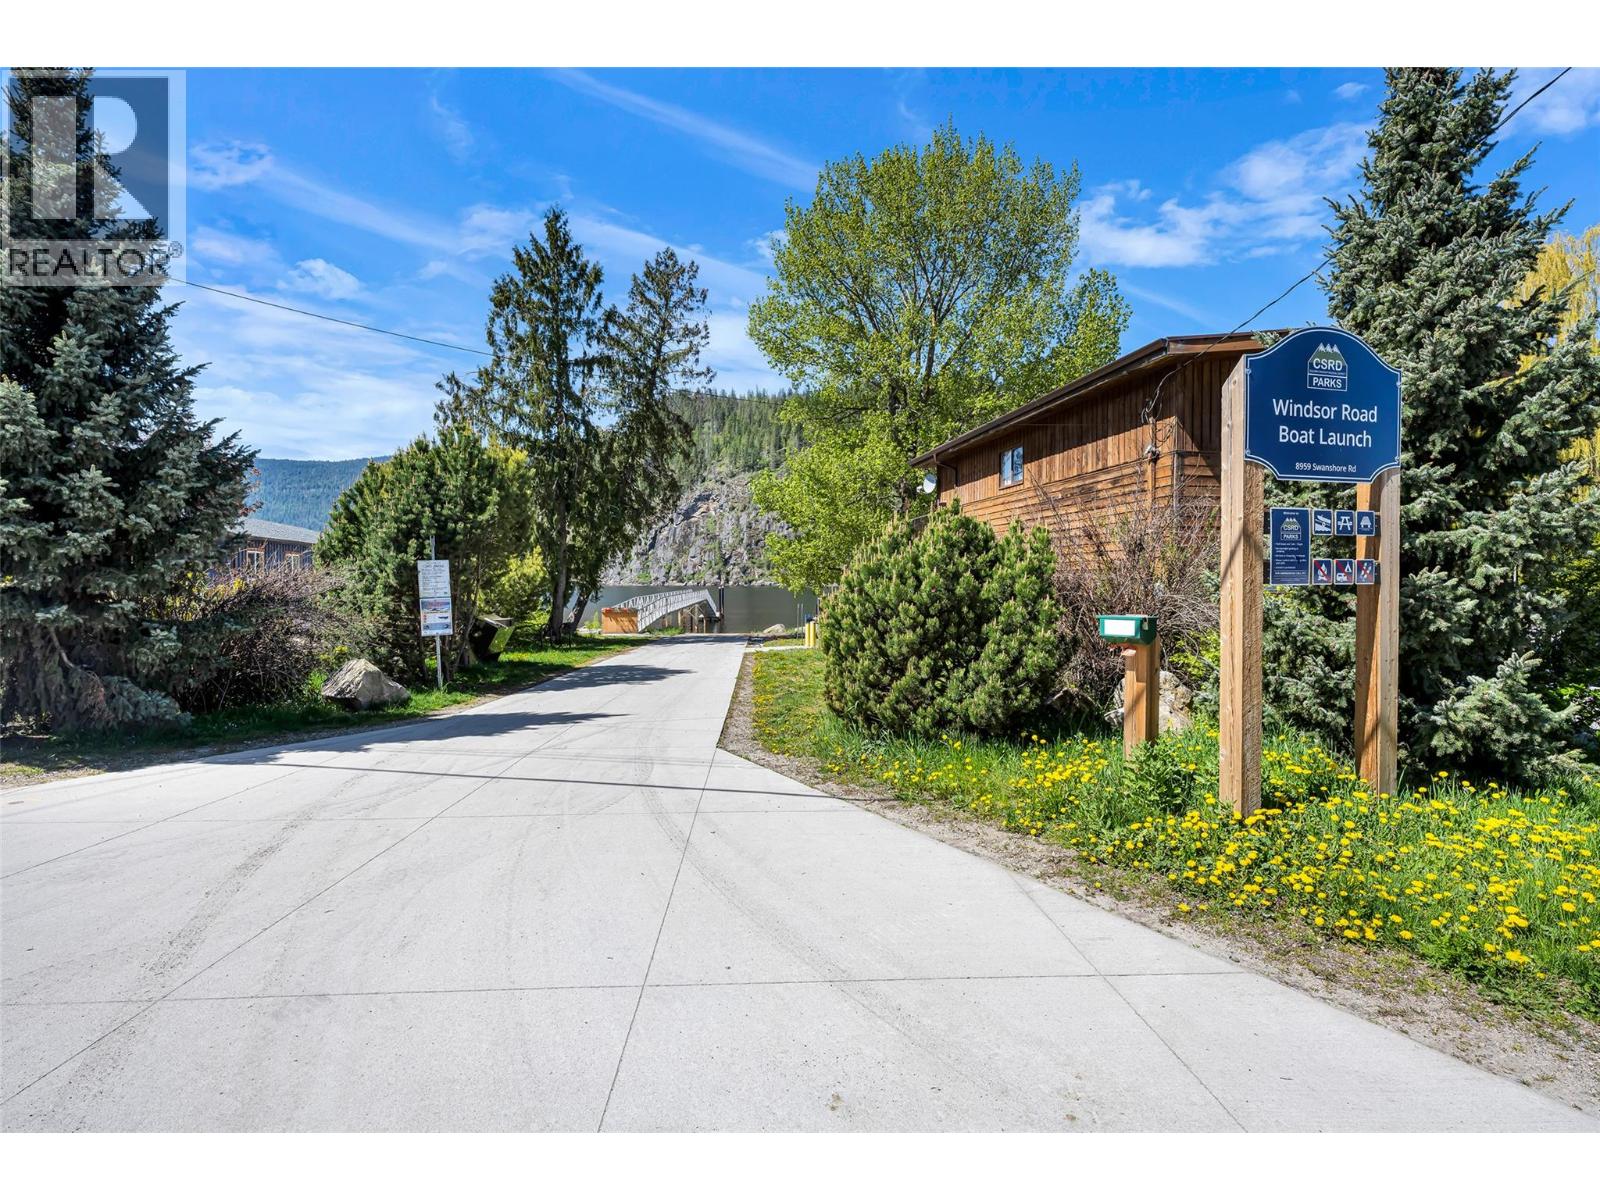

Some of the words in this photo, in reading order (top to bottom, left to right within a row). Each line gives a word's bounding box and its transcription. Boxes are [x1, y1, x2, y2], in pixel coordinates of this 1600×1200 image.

[1312, 358, 1343, 371] CSRD
[1312, 377, 1342, 389] PARKS
[1272, 398, 1337, 420] Windsor
[1341, 404, 1378, 423] Road
[1279, 425, 1315, 444] Boat
[1319, 428, 1372, 447] Launch
[1295, 462, 1311, 471] 8959
[1312, 463, 1347, 472] Swanshore
[1348, 464, 1357, 473] Rd
